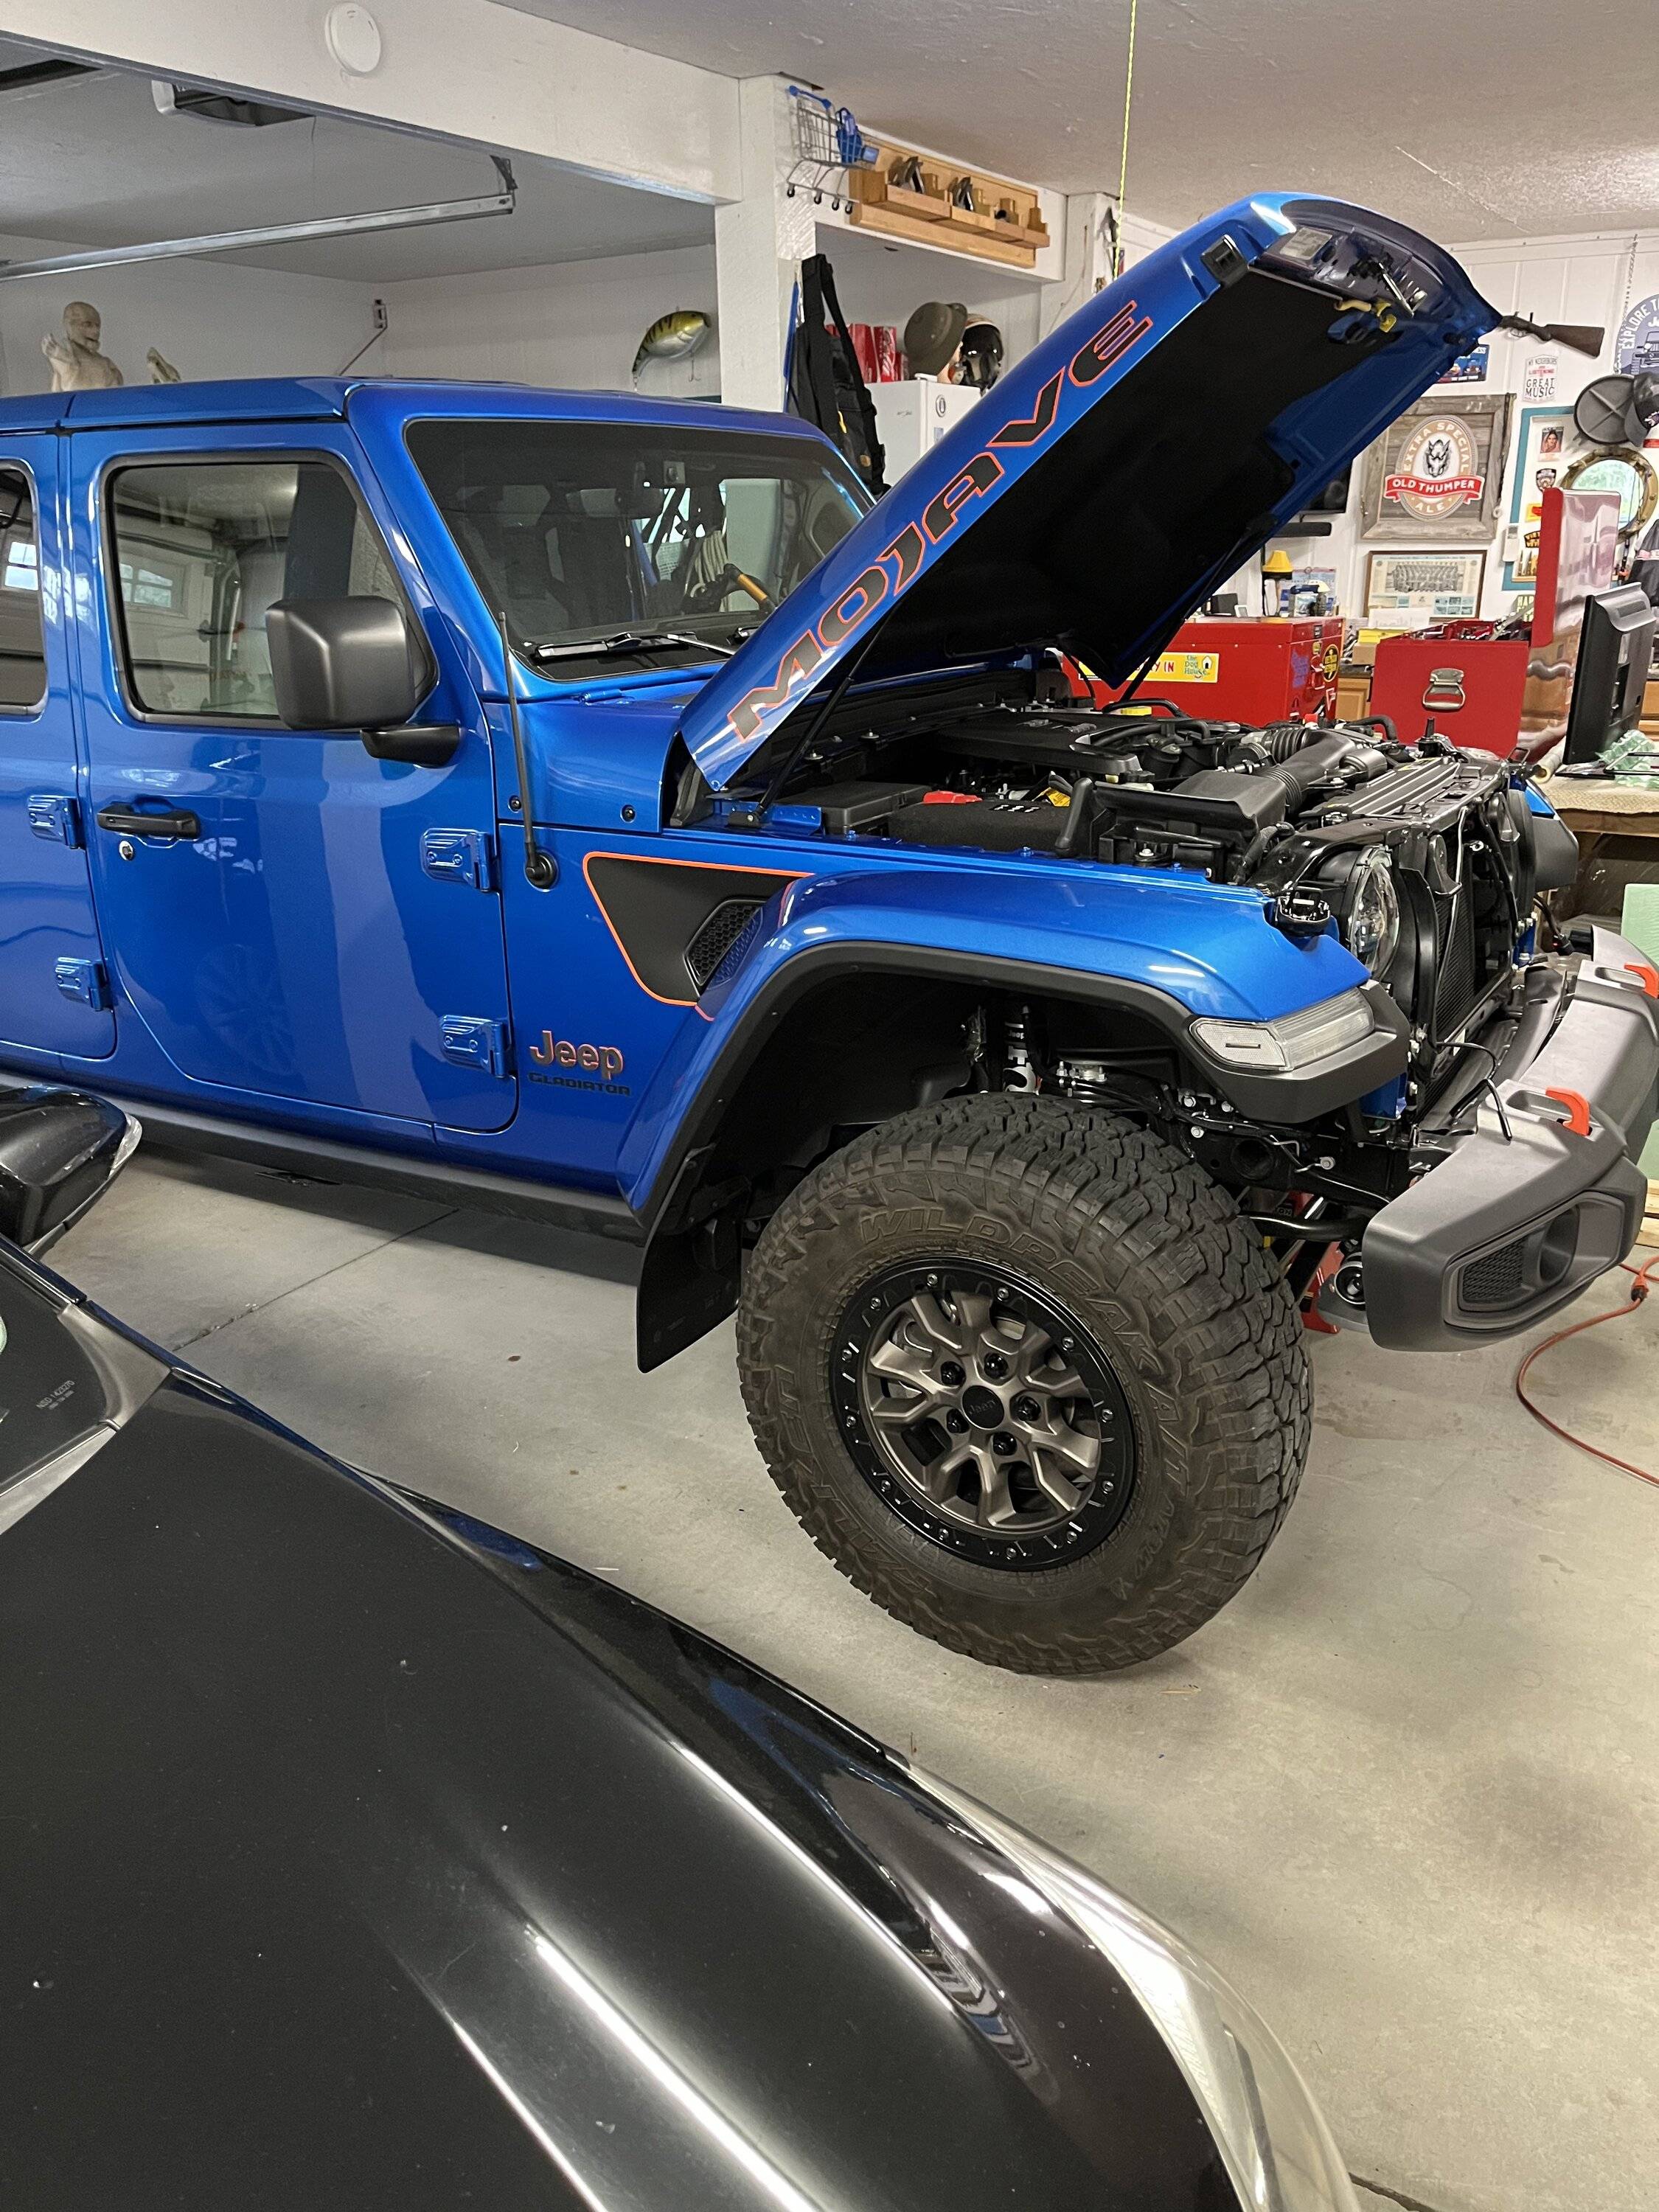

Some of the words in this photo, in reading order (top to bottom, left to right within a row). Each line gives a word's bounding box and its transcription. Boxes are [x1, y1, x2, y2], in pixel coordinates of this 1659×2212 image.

[1621, 303, 1651, 349] EXPLORE
[1526, 378, 1555, 388] GREAT
[1526, 386, 1555, 397] MUSIC
[1403, 428, 1432, 471] EXTRA
[1437, 422, 1470, 472] SPECIAL
[1392, 479, 1416, 488] OLD
[1418, 480, 1475, 493] THUMPER
[727, 300, 1153, 743] MOJAVE
[1415, 502, 1445, 513] ALE
[1164, 661, 1175, 672] IN
[529, 1029, 624, 1080] Jeep
[527, 1072, 630, 1096] GLADIATOR
[860, 1207, 1165, 1376] WILDPEAK
[774, 1364, 937, 1599] FALKEN
